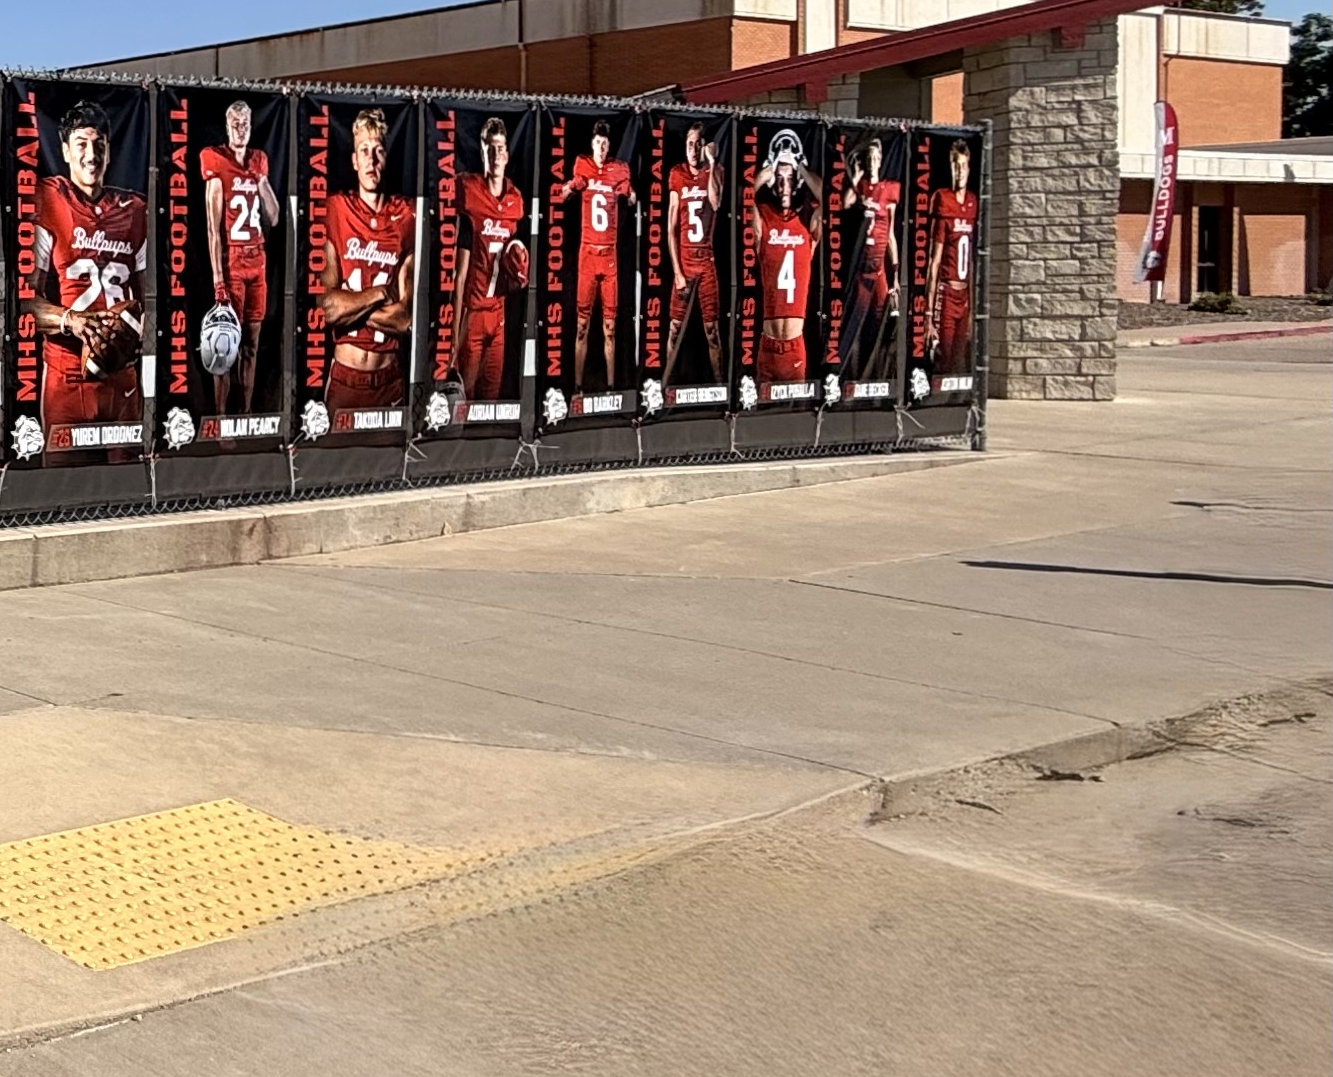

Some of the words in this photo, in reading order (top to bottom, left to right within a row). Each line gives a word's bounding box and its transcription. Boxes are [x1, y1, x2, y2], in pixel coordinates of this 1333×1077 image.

[17, 91, 40, 300] FOOTBALL
[169, 99, 188, 298] FOOTBALL
[230, 195, 262, 241] 24
[307, 105, 329, 294] FOOTBALL
[437, 110, 456, 291] FOOTBALL
[546, 117, 566, 291] FOOTBALL
[591, 194, 609, 232] 6
[646, 119, 665, 285] FOOTBALL
[687, 201, 704, 242] 5
[741, 127, 759, 287] FOOTBALL
[914, 136, 931, 286] FOOTBALL
[1155, 154, 1174, 241] BULLDOGS
[71, 226, 134, 258] Bullpups
[344, 237, 399, 268] Bullpups
[486, 242, 504, 298] 7
[777, 250, 796, 303] 4
[958, 235, 969, 280] 0
[17, 318, 37, 401] MHS
[169, 316, 188, 395] MHS
[306, 308, 326, 388] MHS
[434, 303, 455, 380] MHS
[545, 302, 564, 376] MHS
[645, 296, 662, 368] MHS
[741, 297, 757, 367] MHS
[912, 294, 925, 358] MHS
[220, 418, 248, 438] NOLAN
